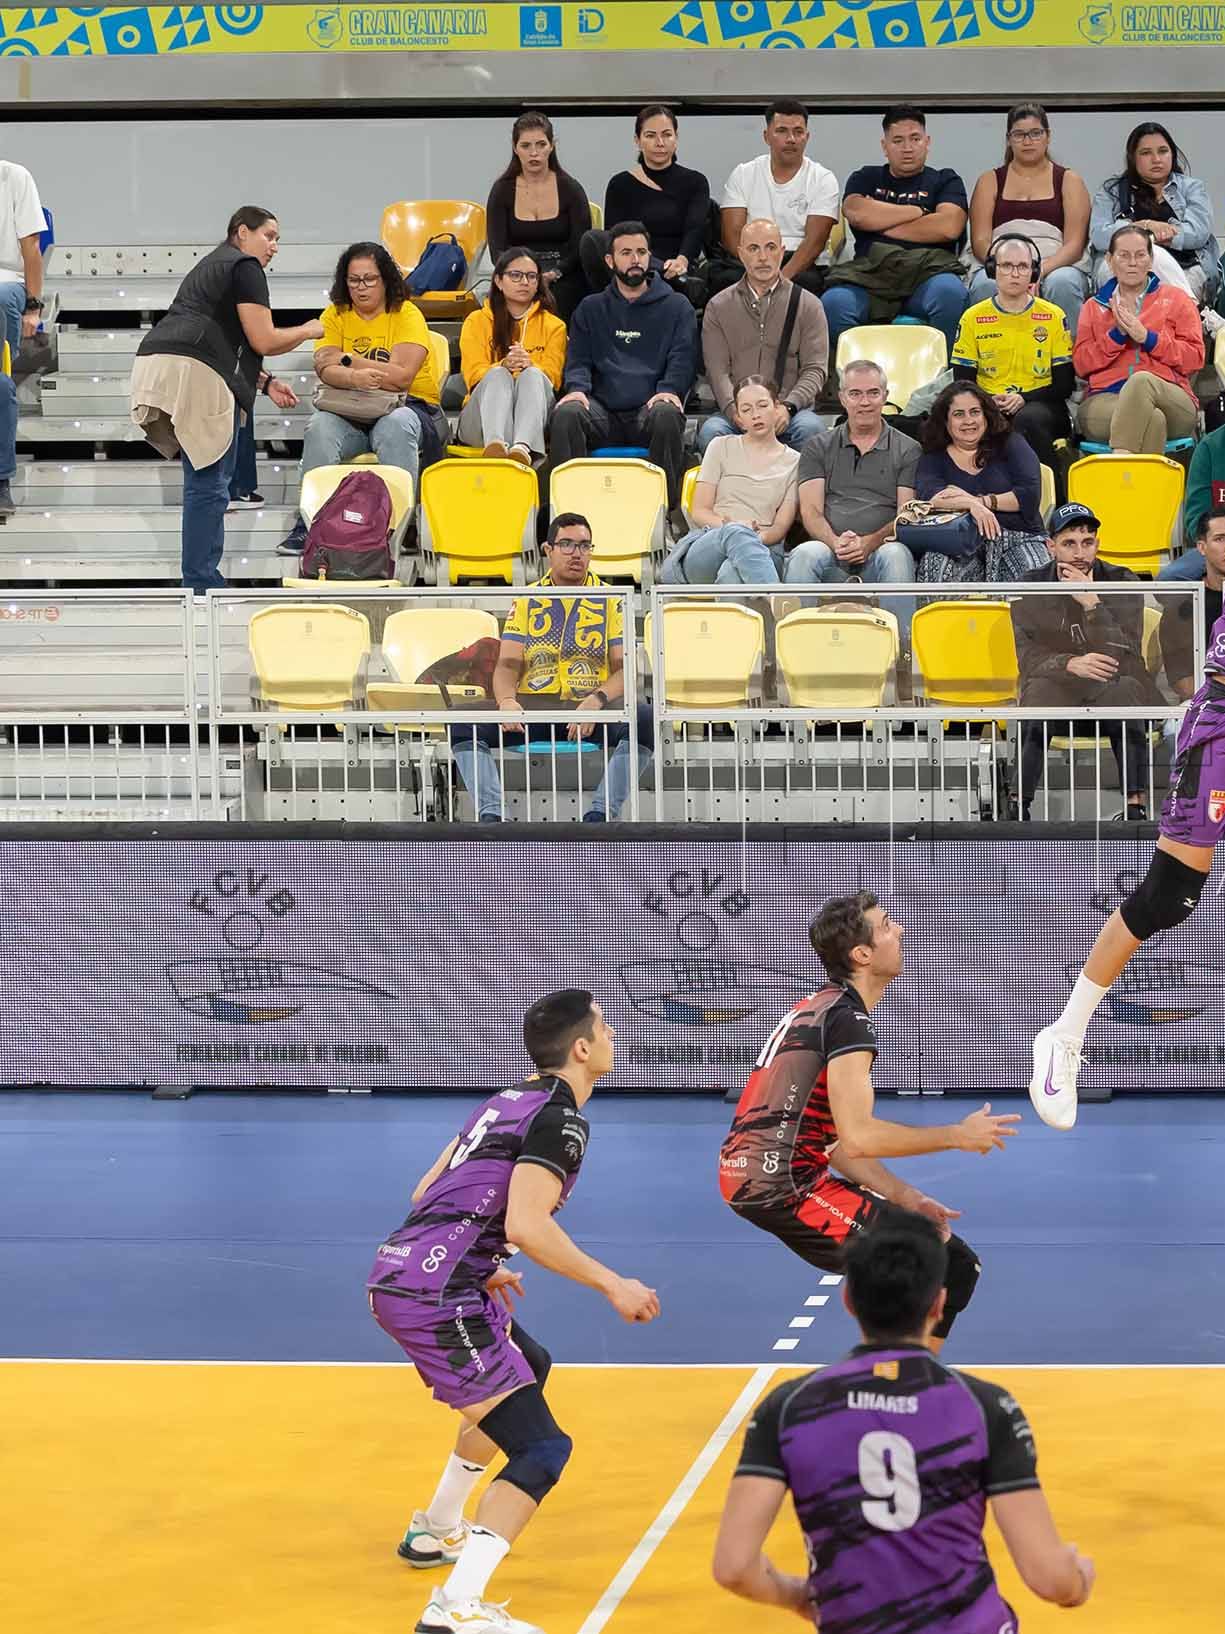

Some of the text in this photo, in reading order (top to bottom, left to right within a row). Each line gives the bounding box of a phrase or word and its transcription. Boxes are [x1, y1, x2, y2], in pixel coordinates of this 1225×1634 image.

[349, 9, 488, 35] GRAN CANARIA
[1121, 6, 1175, 32] GRAN
[350, 37, 449, 45] CLUB DE BALONCESTO
[1122, 33, 1223, 41] CLUB DE BALONCESTO
[450, 1108, 501, 1170] 5
[847, 1390, 919, 1414] LINARES
[858, 1430, 921, 1531] 9
